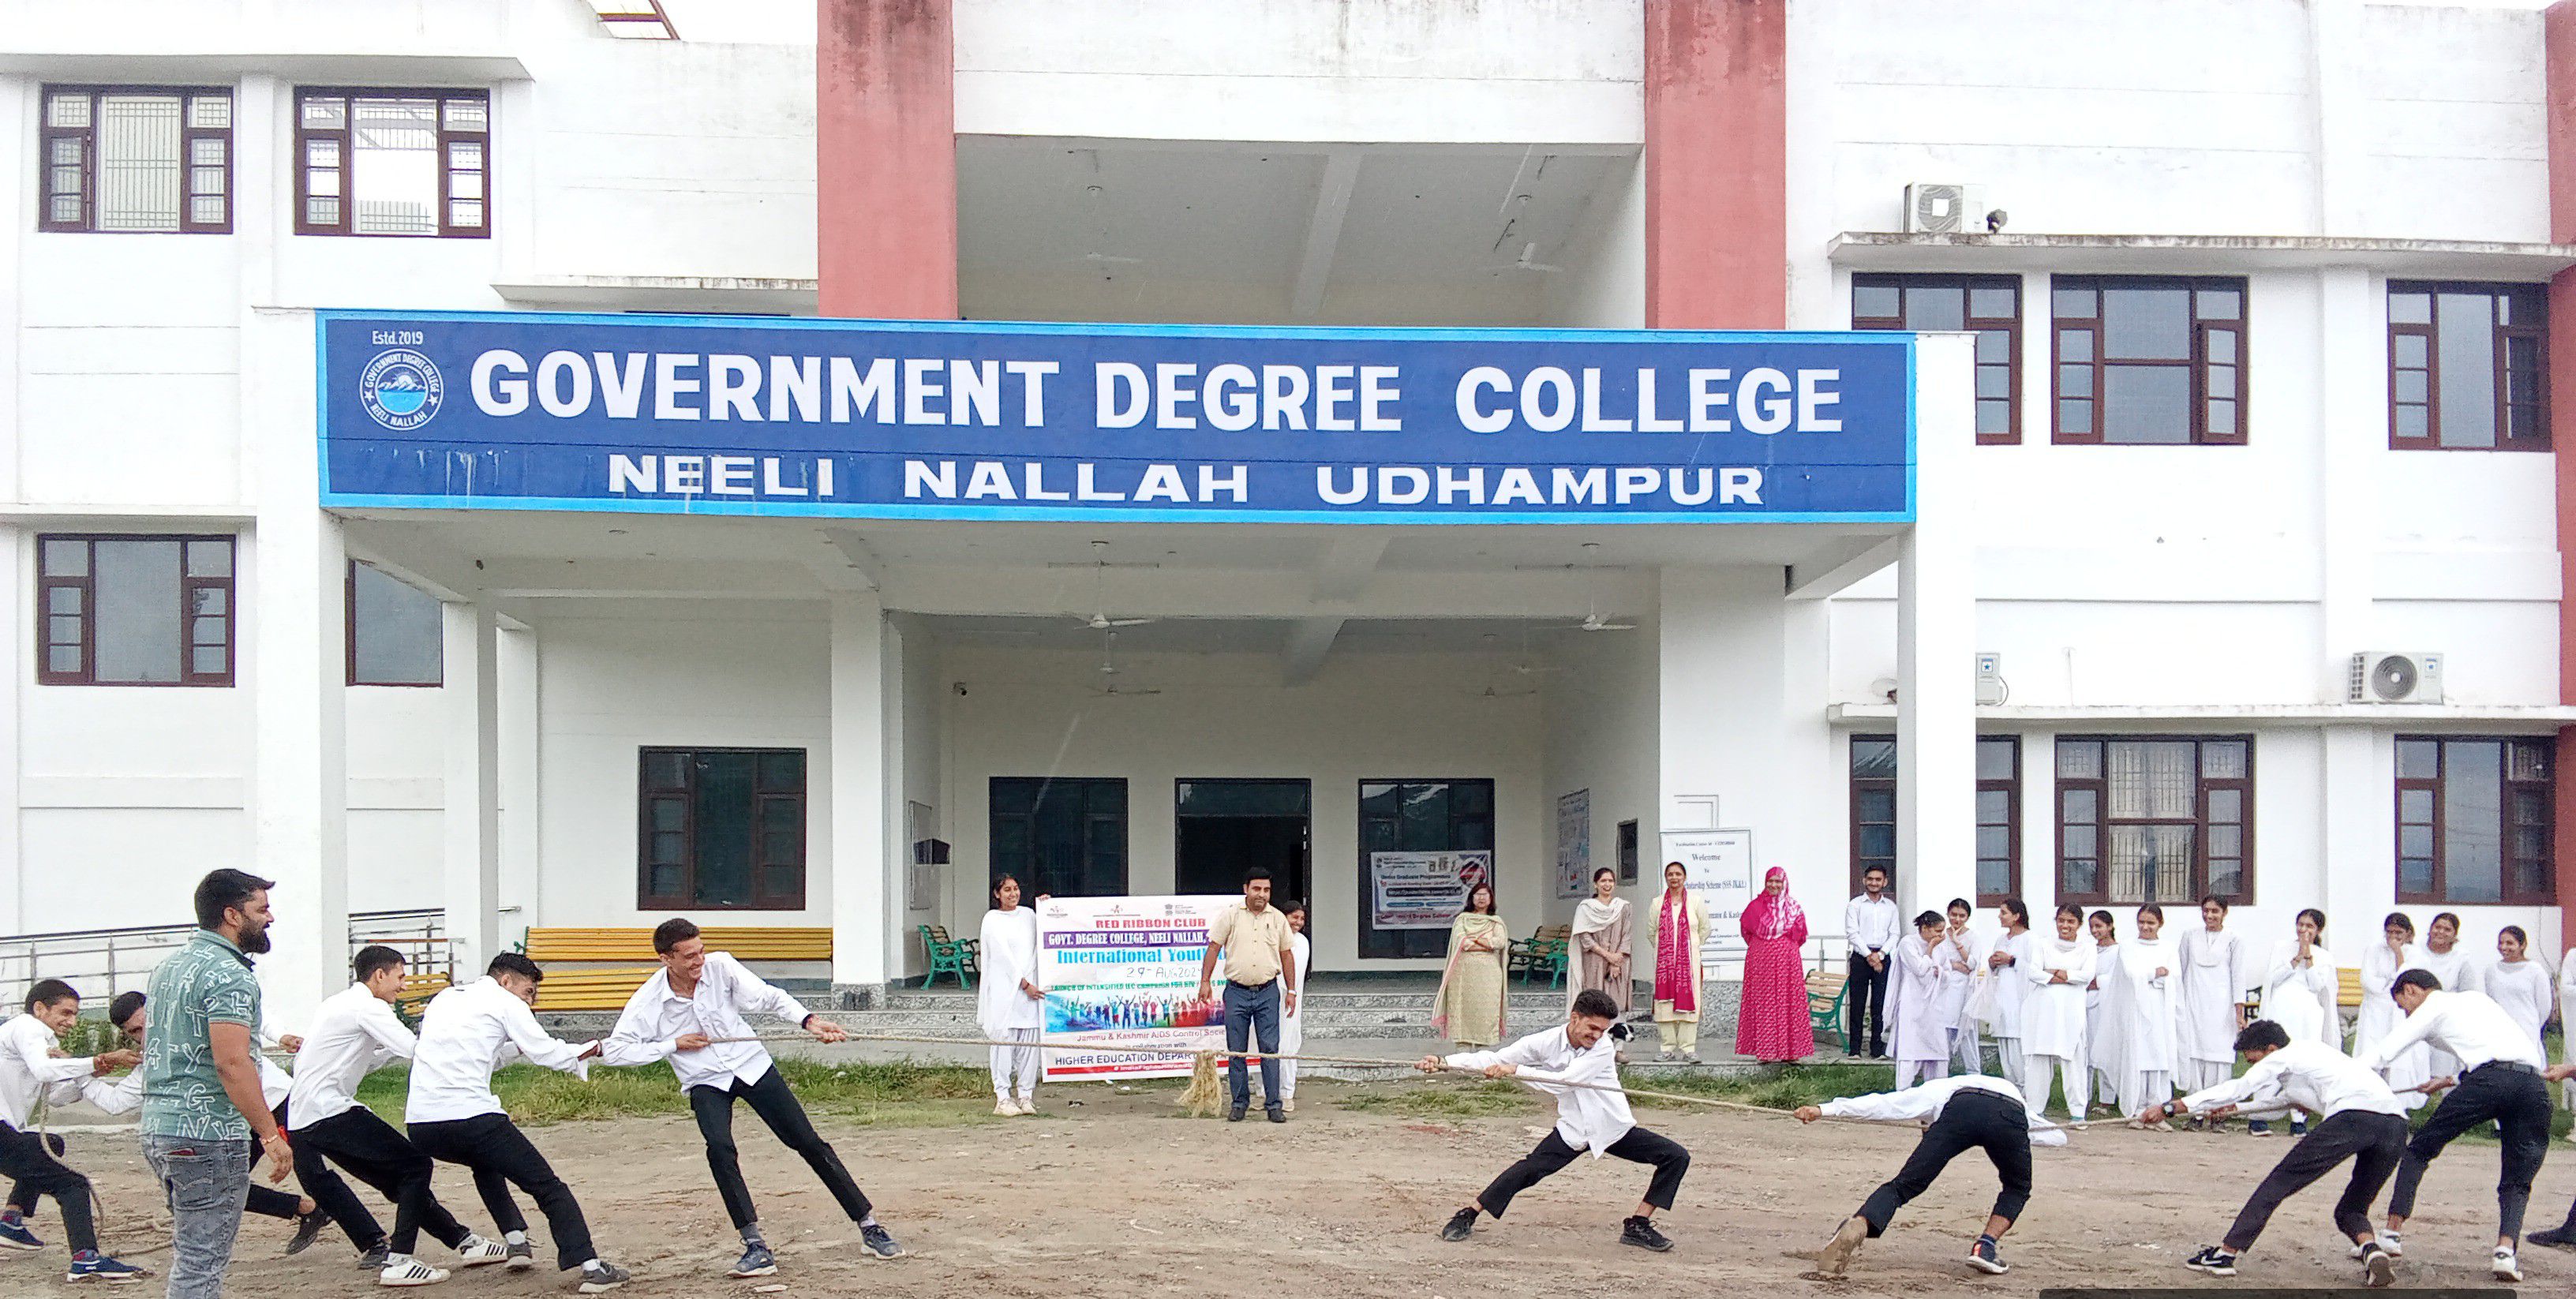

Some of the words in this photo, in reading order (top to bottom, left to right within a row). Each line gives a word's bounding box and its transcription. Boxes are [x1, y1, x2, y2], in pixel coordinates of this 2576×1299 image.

[364, 353, 402, 388] GOVERNMENT
[402, 353, 425, 368] DEGREE
[471, 350, 1060, 427] GOVERNMENT
[1095, 362, 1402, 432] DEGREE
[1455, 366, 1843, 435] COLLEGE
[370, 402, 390, 422] NEELI
[390, 410, 428, 427] NALLAH
[608, 454, 833, 500] NEELI
[904, 460, 1248, 502] NALLAH
[1317, 466, 1763, 505] UDHAMPUR
[1095, 919, 1120, 929] RED
[1122, 919, 1171, 928] RIBBON
[1174, 918, 1207, 927] CLUB
[1075, 933, 1108, 945] DEGREE
[1148, 932, 1171, 944] NEELI
[1057, 949, 1163, 964] International
[1076, 1034, 1106, 1043] Jammu
[1116, 1031, 1150, 1041] Kashmir
[1151, 1030, 1170, 1039] AIDS
[1172, 1029, 1201, 1038] Control
[1055, 1055, 1094, 1066] HIGHER
[1096, 1052, 1155, 1064] EDUCATION
